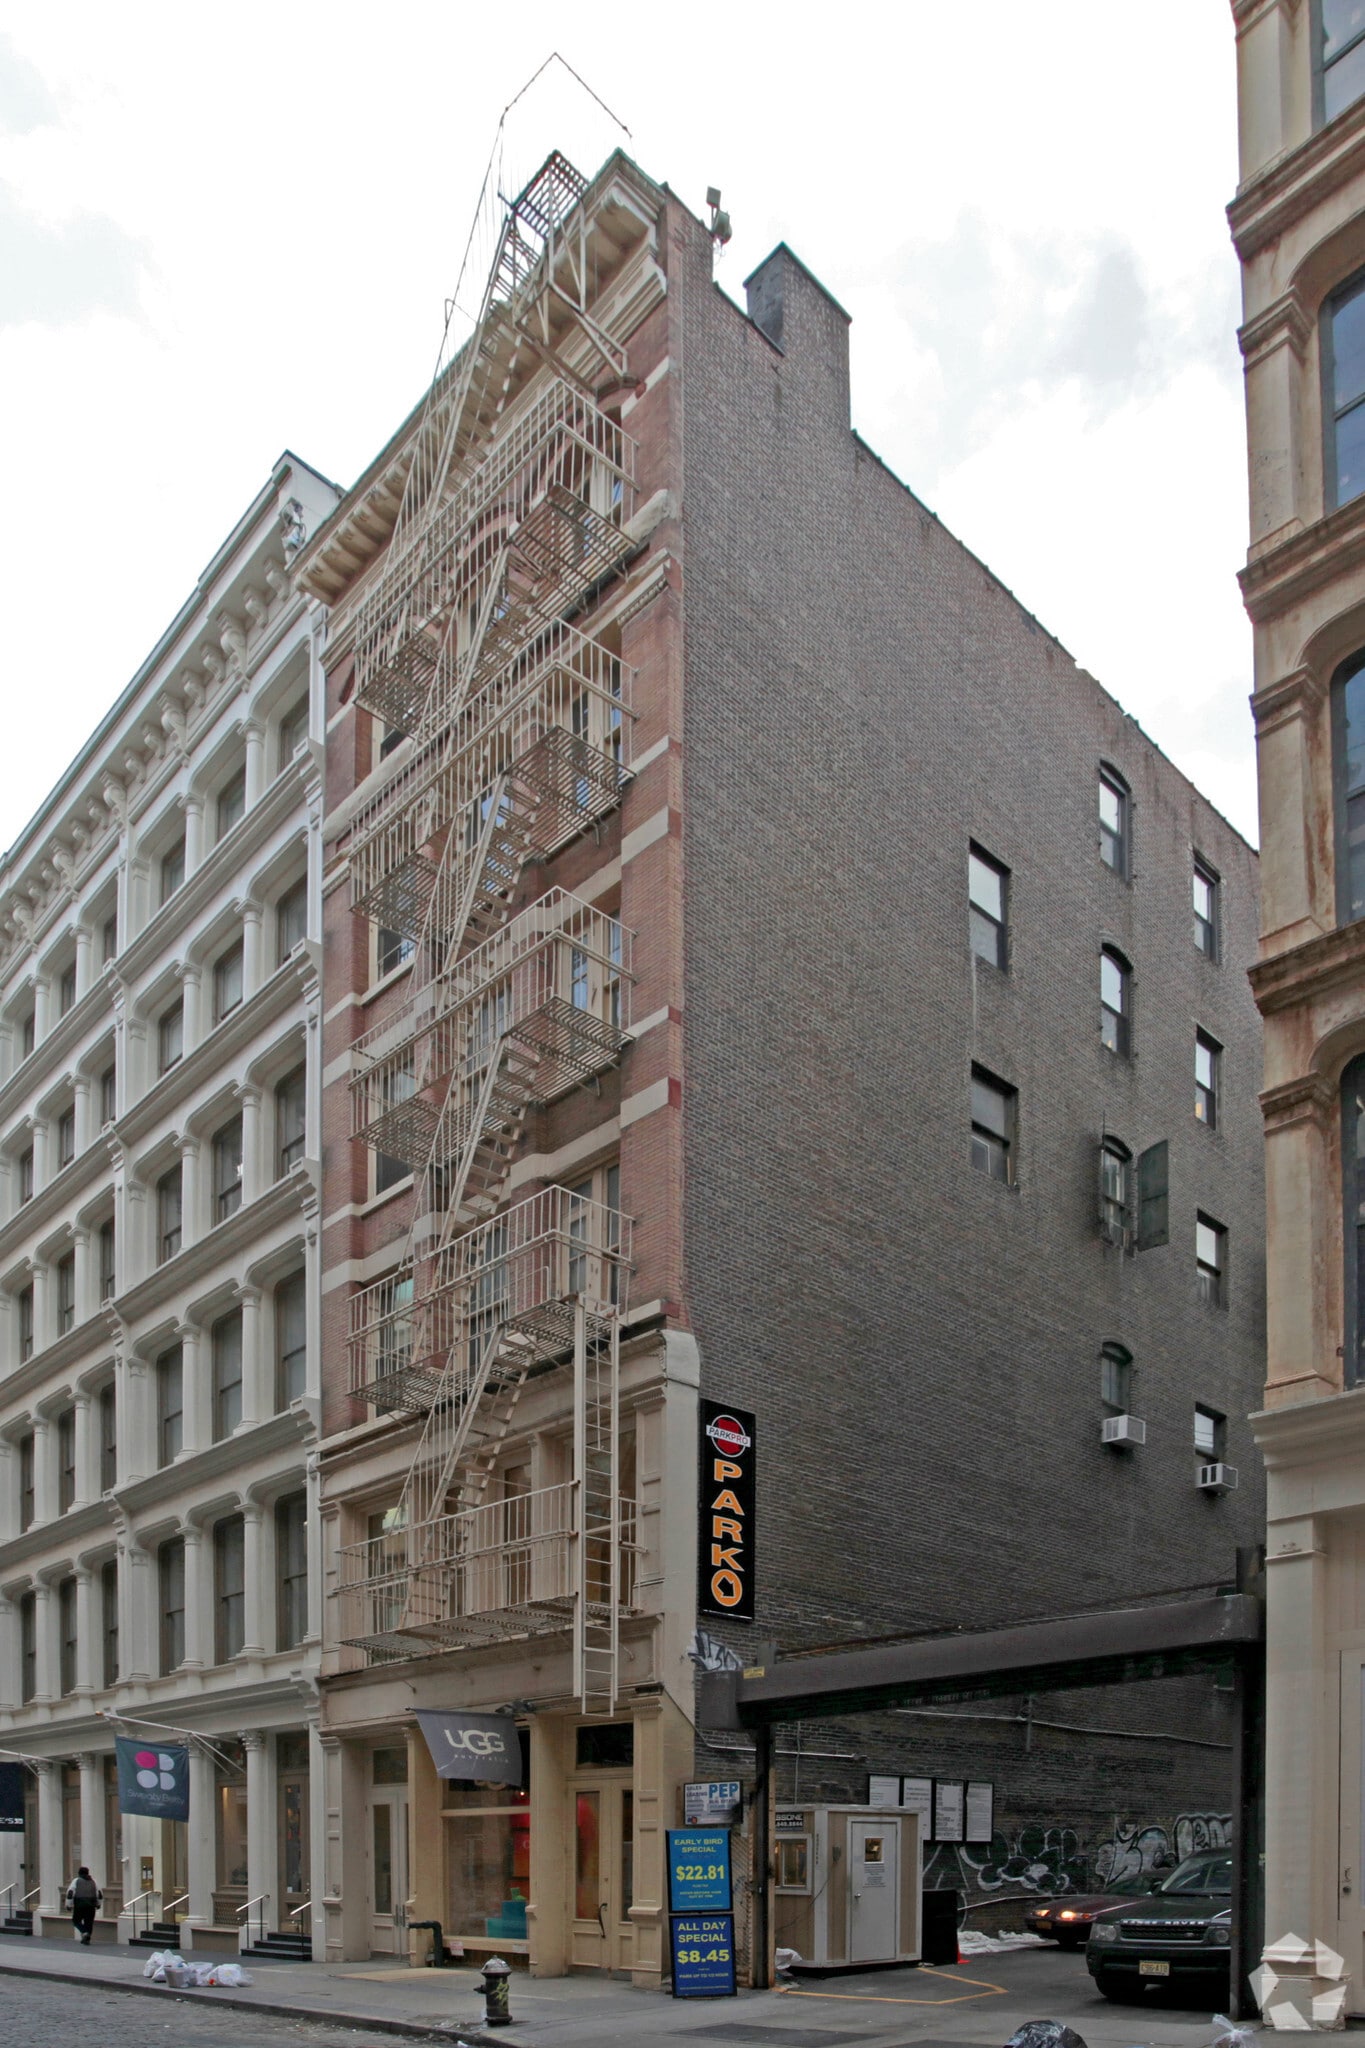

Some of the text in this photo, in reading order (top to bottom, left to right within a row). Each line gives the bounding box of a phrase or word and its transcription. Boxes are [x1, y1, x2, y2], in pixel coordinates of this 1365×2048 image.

[708, 1427, 748, 1445] PARKPRO
[444, 1729, 505, 1755] UGG
[708, 1783, 738, 1798] PEP
[676, 1865, 725, 1881] $22.81
[678, 1921, 726, 1931] ALL DAY
[678, 1933, 727, 1943] SPECIAL
[677, 1949, 730, 1965] $8.45
